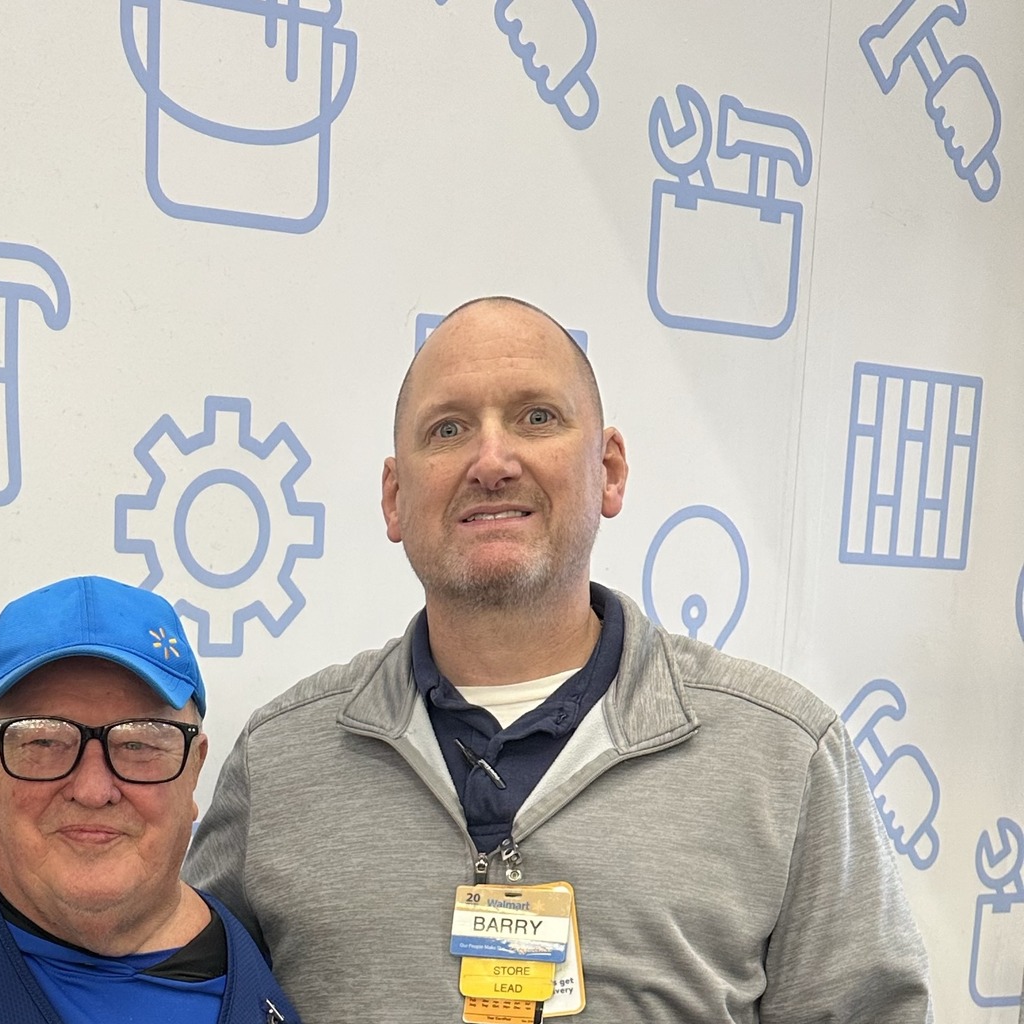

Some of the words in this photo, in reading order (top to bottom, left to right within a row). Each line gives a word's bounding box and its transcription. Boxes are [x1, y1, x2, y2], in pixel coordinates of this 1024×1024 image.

[466, 893, 480, 902] 20
[487, 899, 530, 910] Walmart
[473, 916, 543, 935] BARRY
[493, 966, 530, 976] STORE
[559, 977, 574, 987] get
[494, 983, 522, 993] LEAD
